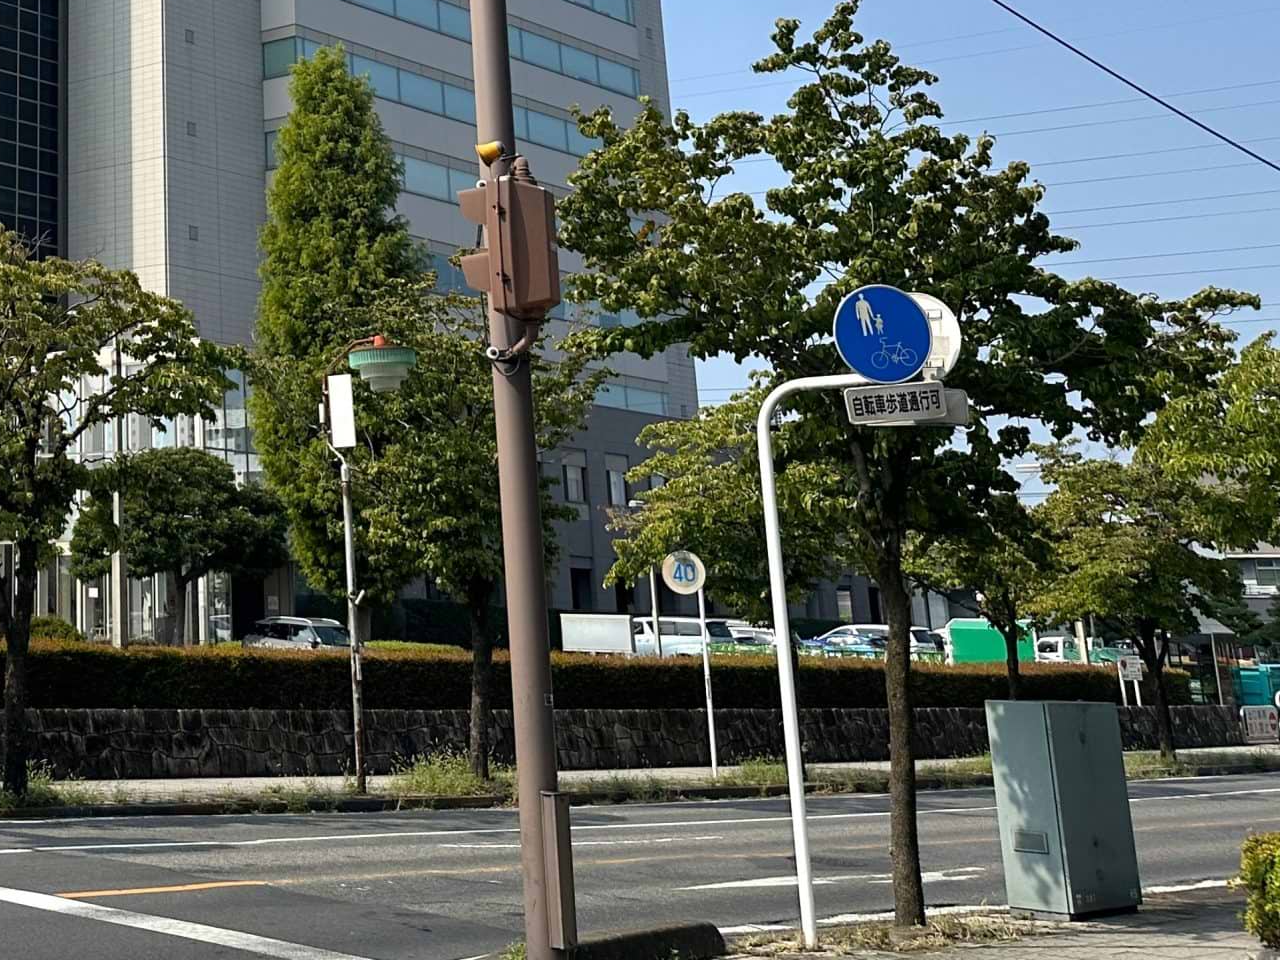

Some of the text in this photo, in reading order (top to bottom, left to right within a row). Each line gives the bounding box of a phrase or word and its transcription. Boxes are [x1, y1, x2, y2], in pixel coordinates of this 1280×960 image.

[852, 389, 940, 417] 自転車歩道通行可
[673, 563, 696, 583] 40
